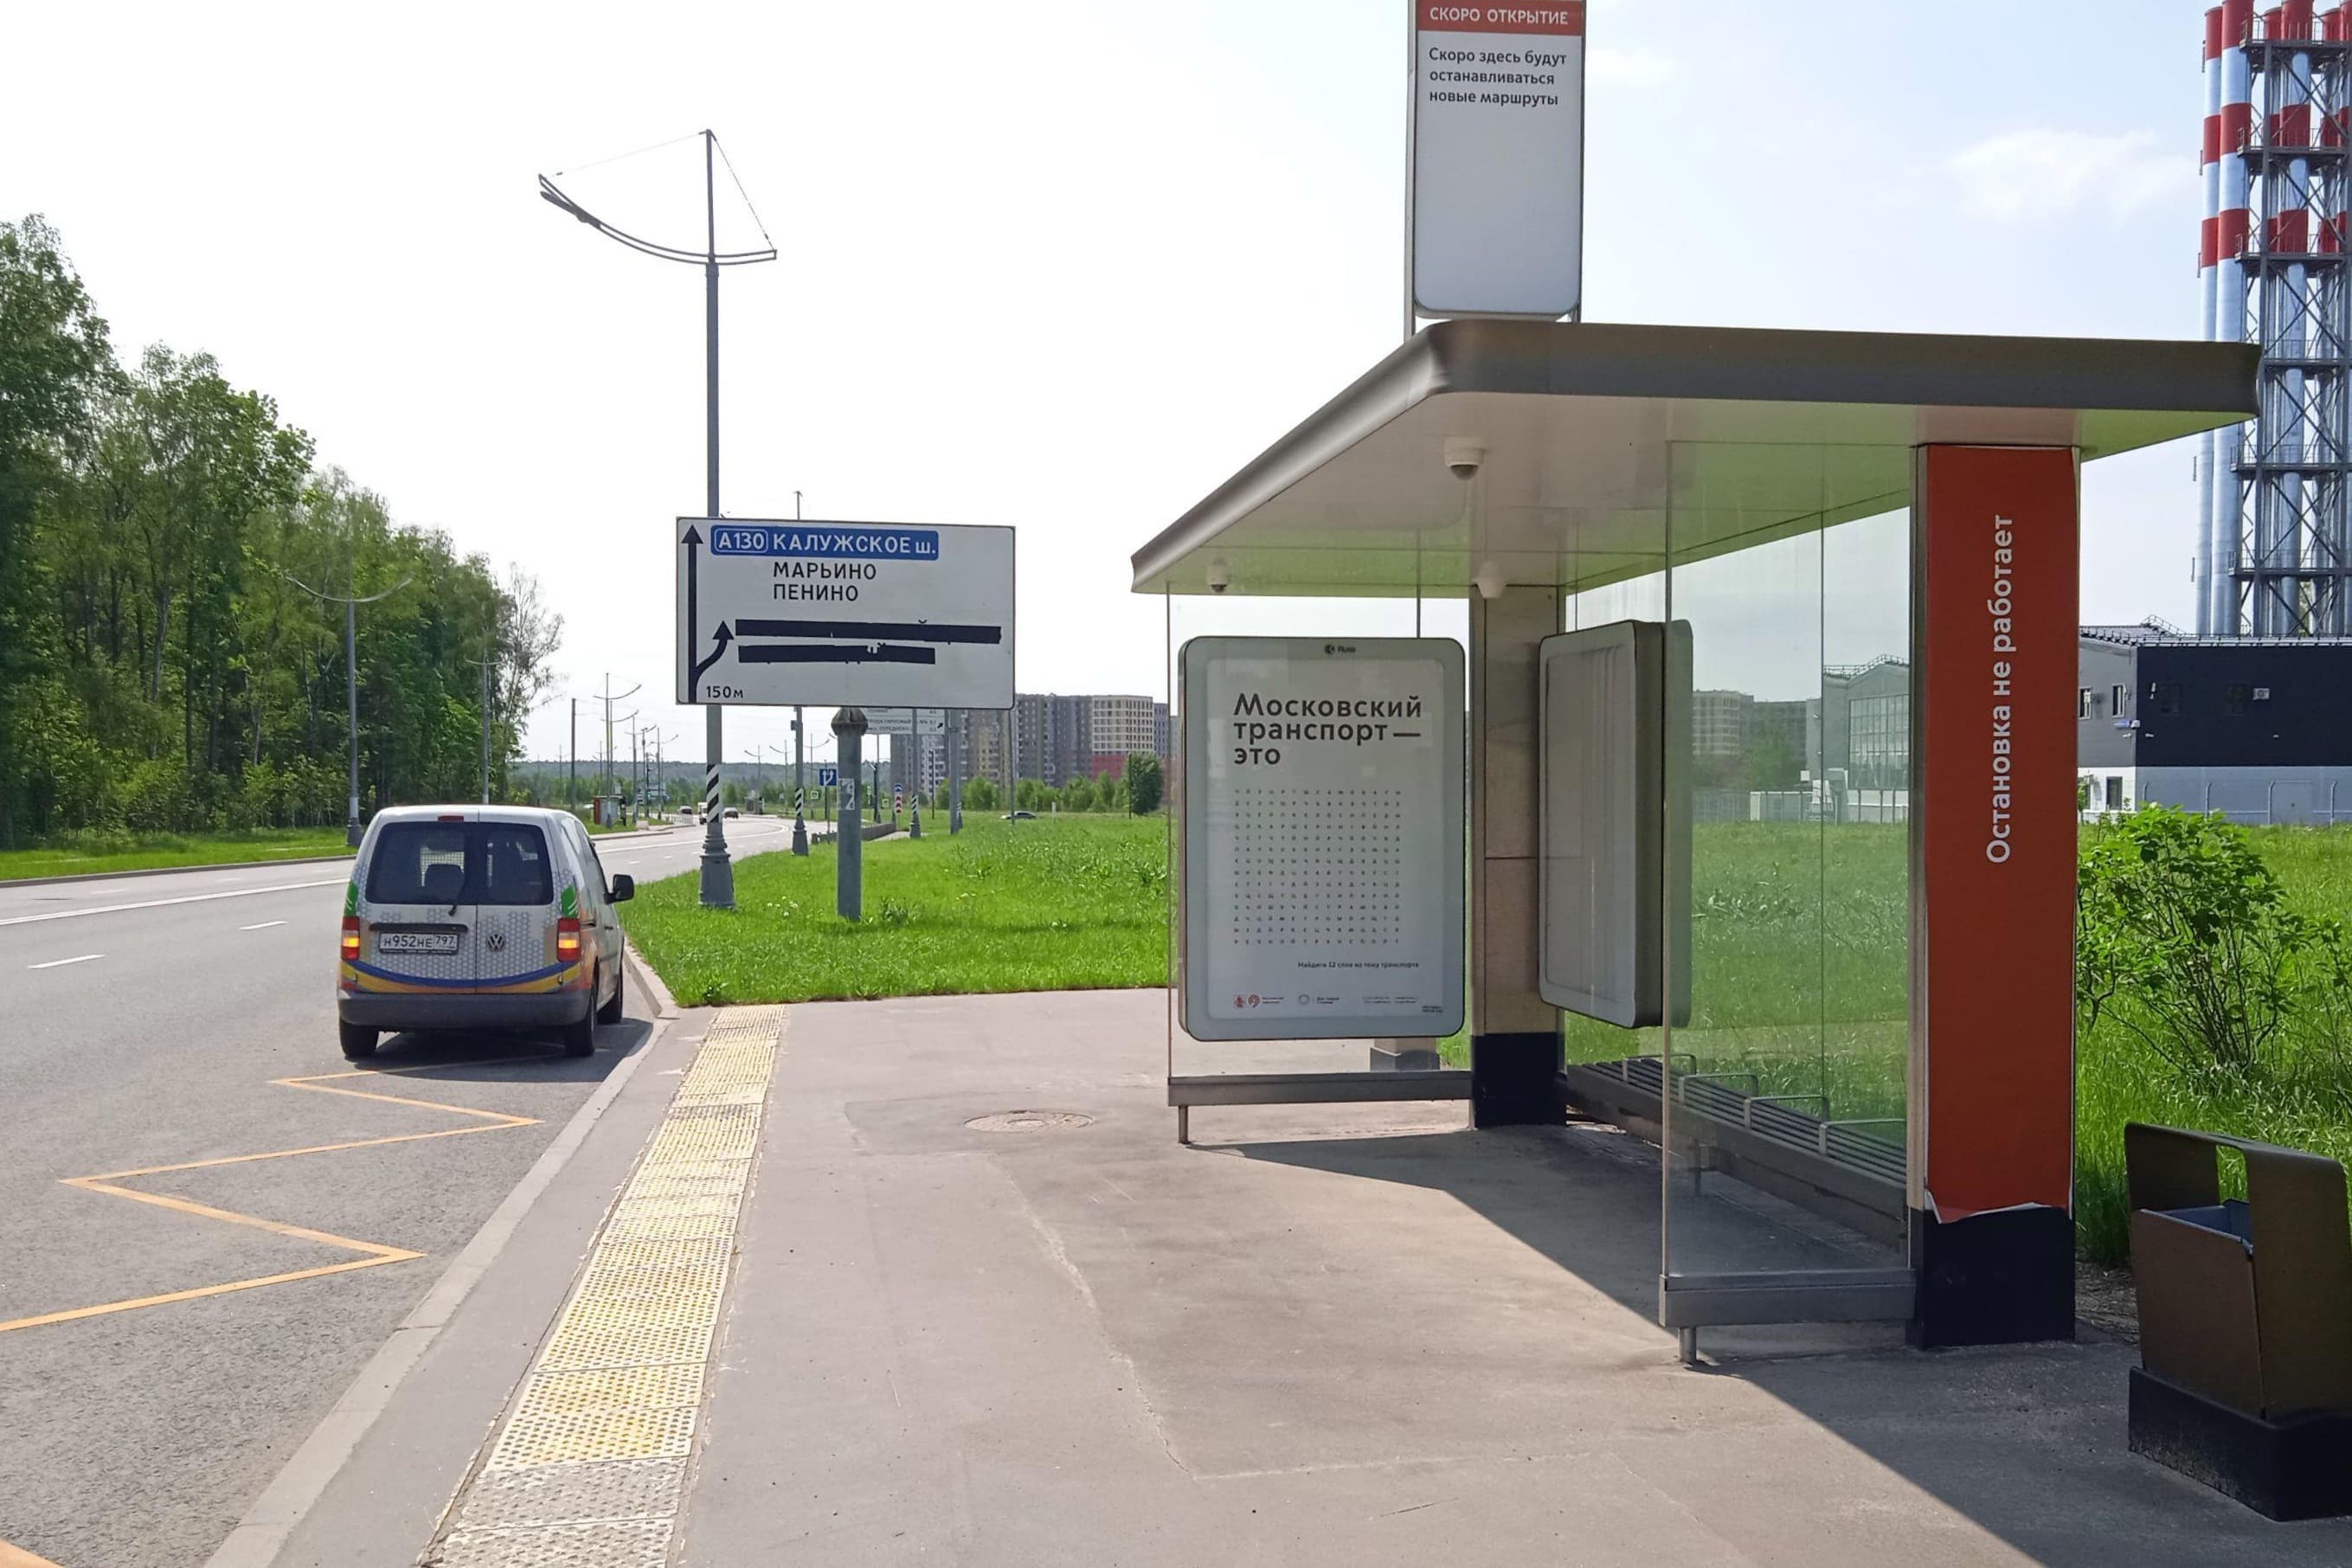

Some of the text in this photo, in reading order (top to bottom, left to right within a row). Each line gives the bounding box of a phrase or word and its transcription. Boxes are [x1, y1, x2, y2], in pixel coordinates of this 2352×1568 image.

[1430, 7, 1569, 25] СКОРО ОТКРЫТИЕ
[1429, 47, 1566, 67] Скоро здесь будут
[1430, 69, 1555, 85] останавливаться
[1430, 91, 1558, 107] новые маршруты
[718, 531, 937, 556] А130 КАЛУЖСКОЕ ш.
[773, 561, 877, 581] МАРЬИНО
[773, 583, 859, 602] ПЕНИНО
[1986, 514, 2017, 864] Остановка не работает
[1233, 692, 1422, 718] Московский
[1233, 721, 1388, 746] транспорт
[1233, 747, 1282, 765] это
